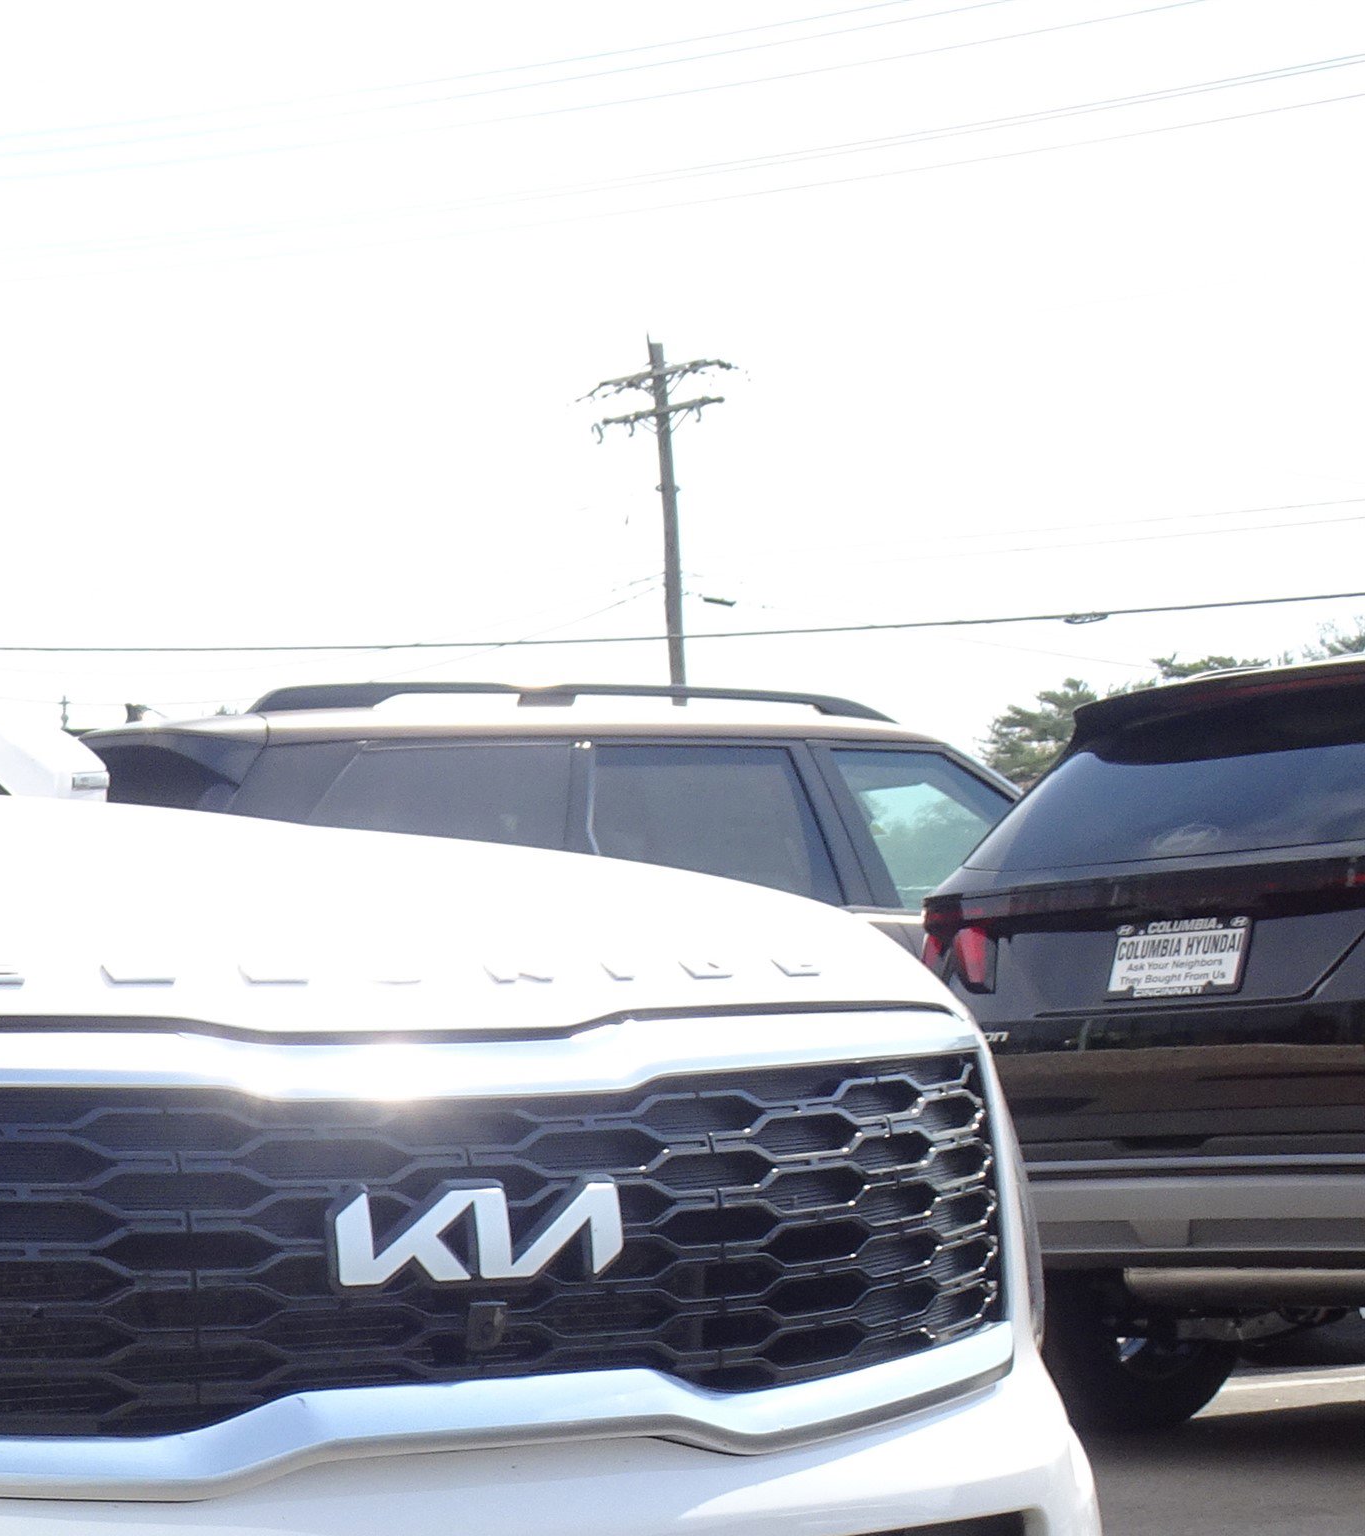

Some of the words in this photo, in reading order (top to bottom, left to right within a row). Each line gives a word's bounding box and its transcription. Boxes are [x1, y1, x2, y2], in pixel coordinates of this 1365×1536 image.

[1147, 917, 1217, 934] COLUMBIA
[1117, 937, 1181, 961] COLUMBIA
[1185, 932, 1242, 956] HYUNDAI
[1126, 963, 1145, 973] Ask
[1147, 961, 1169, 971] Your
[1171, 958, 1223, 970] Neighbors
[1119, 975, 1142, 986] They
[1144, 973, 1182, 985] Bought
[1184, 971, 1209, 981] From
[1212, 969, 1226, 980] Us
[333, 1180, 625, 1288] KIA
